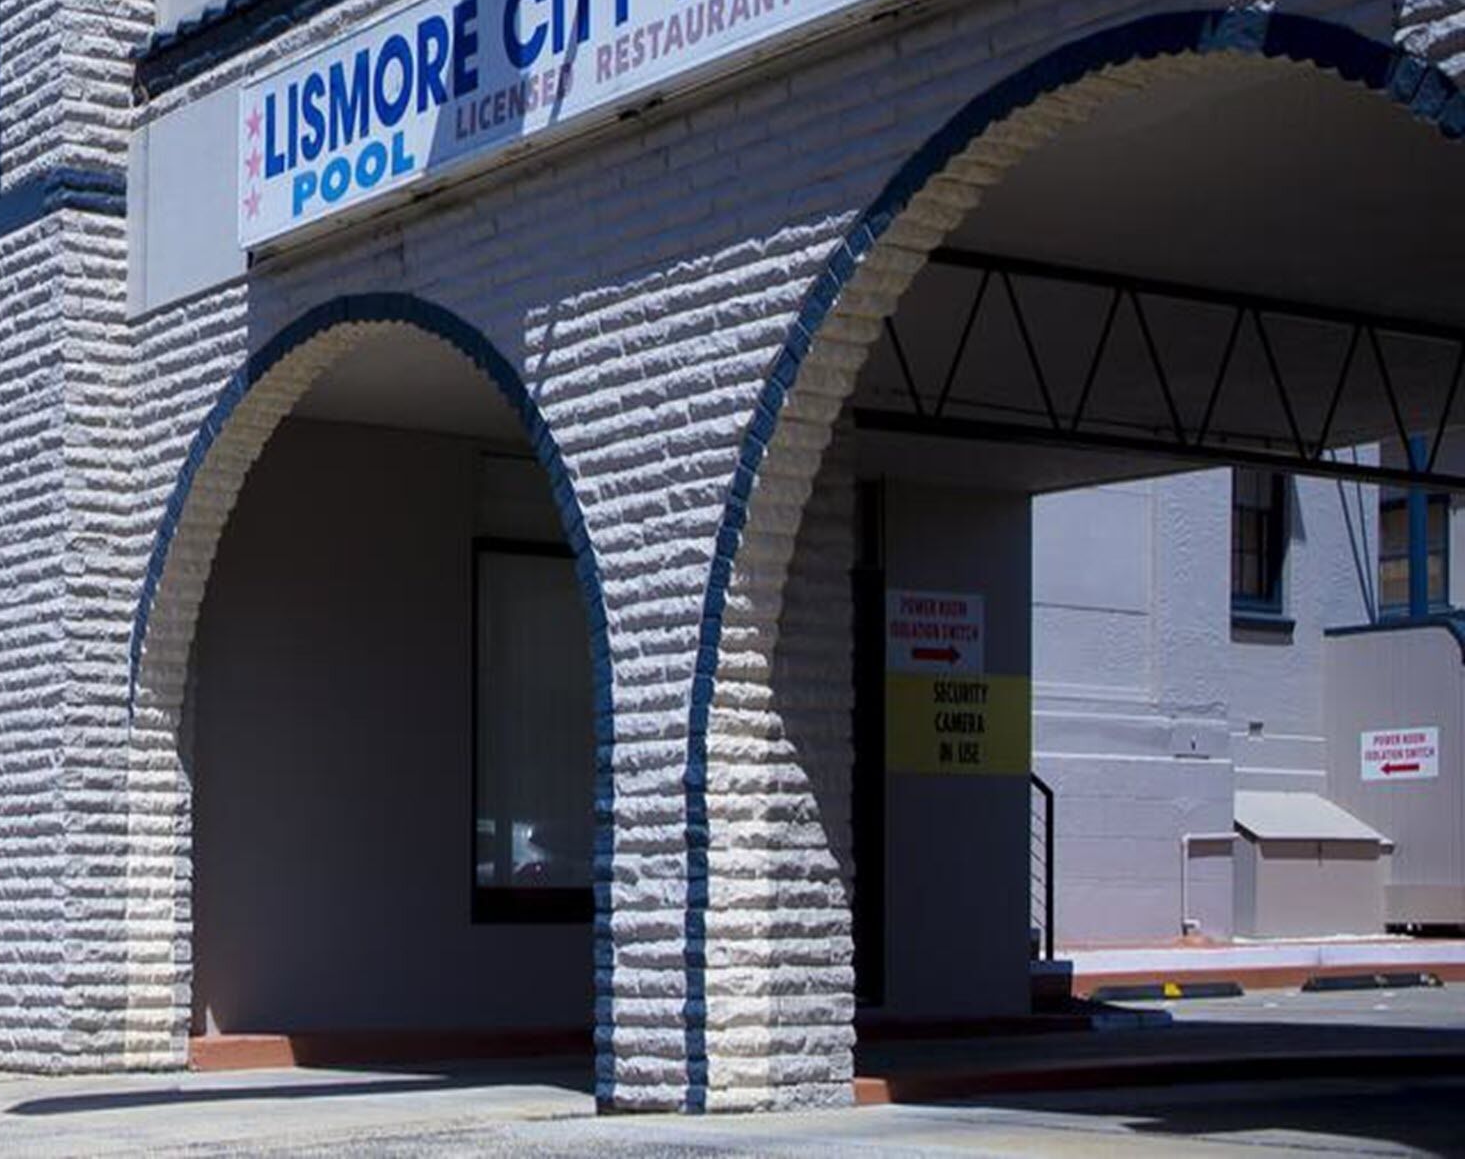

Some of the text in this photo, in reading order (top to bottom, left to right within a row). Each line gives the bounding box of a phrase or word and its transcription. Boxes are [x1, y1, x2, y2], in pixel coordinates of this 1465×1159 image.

[455, 62, 574, 140] LICENSED
[291, 132, 415, 216] POOL
[934, 681, 989, 704] SECURITY
[934, 711, 985, 734] CAMERA
[958, 741, 980, 764] USE
